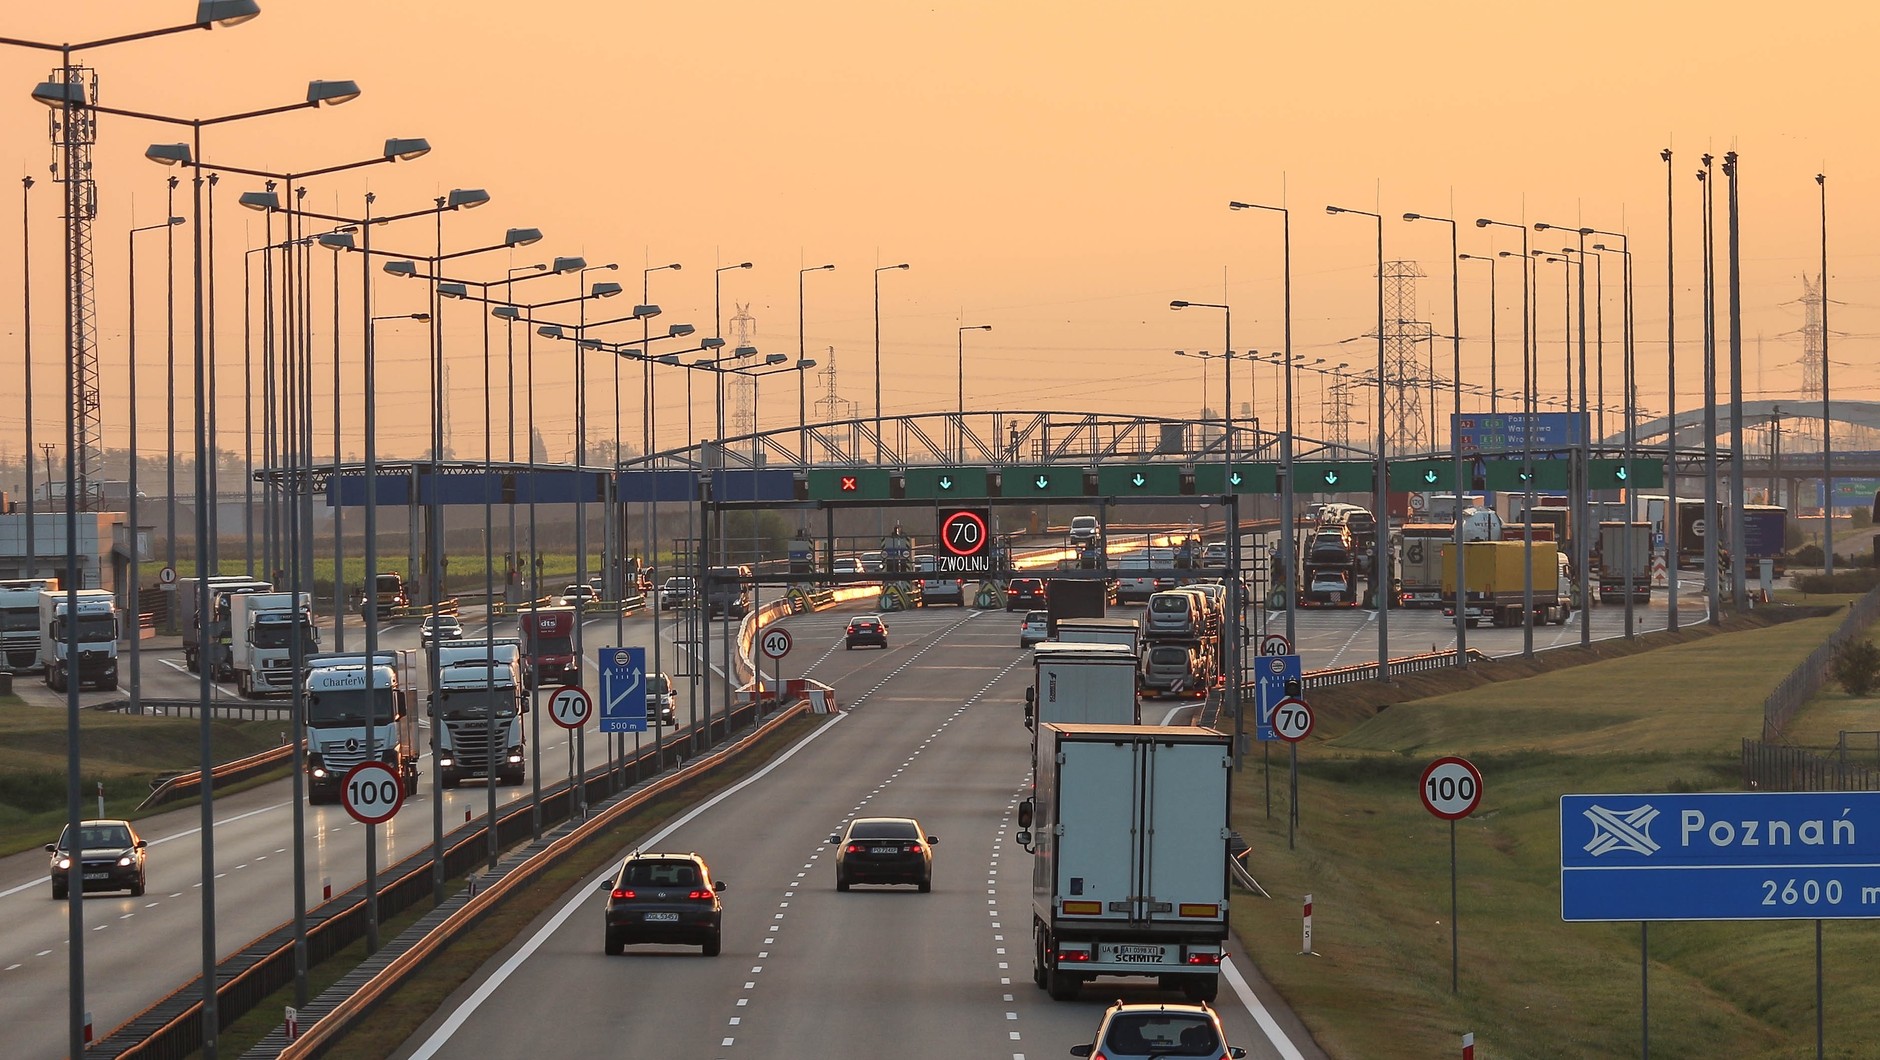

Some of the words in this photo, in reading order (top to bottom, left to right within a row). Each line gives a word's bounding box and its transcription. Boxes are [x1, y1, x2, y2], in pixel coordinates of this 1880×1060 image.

[952, 523, 977, 543] 70
[1656, 534, 1663, 543] P
[940, 556, 989, 571] ZWOLNIJ
[766, 637, 786, 651] 40
[1266, 642, 1286, 656] 40
[323, 676, 376, 687] CharterW
[557, 697, 586, 718] 70
[611, 722, 627, 730] 500
[1281, 710, 1308, 731] 70
[350, 780, 397, 806] 100
[1427, 776, 1475, 802] 100
[1681, 807, 1856, 847] Poznań
[1761, 879, 1843, 906] 2600
[1861, 887, 1880, 904] m
[1115, 954, 1163, 963] SCHMITZ
